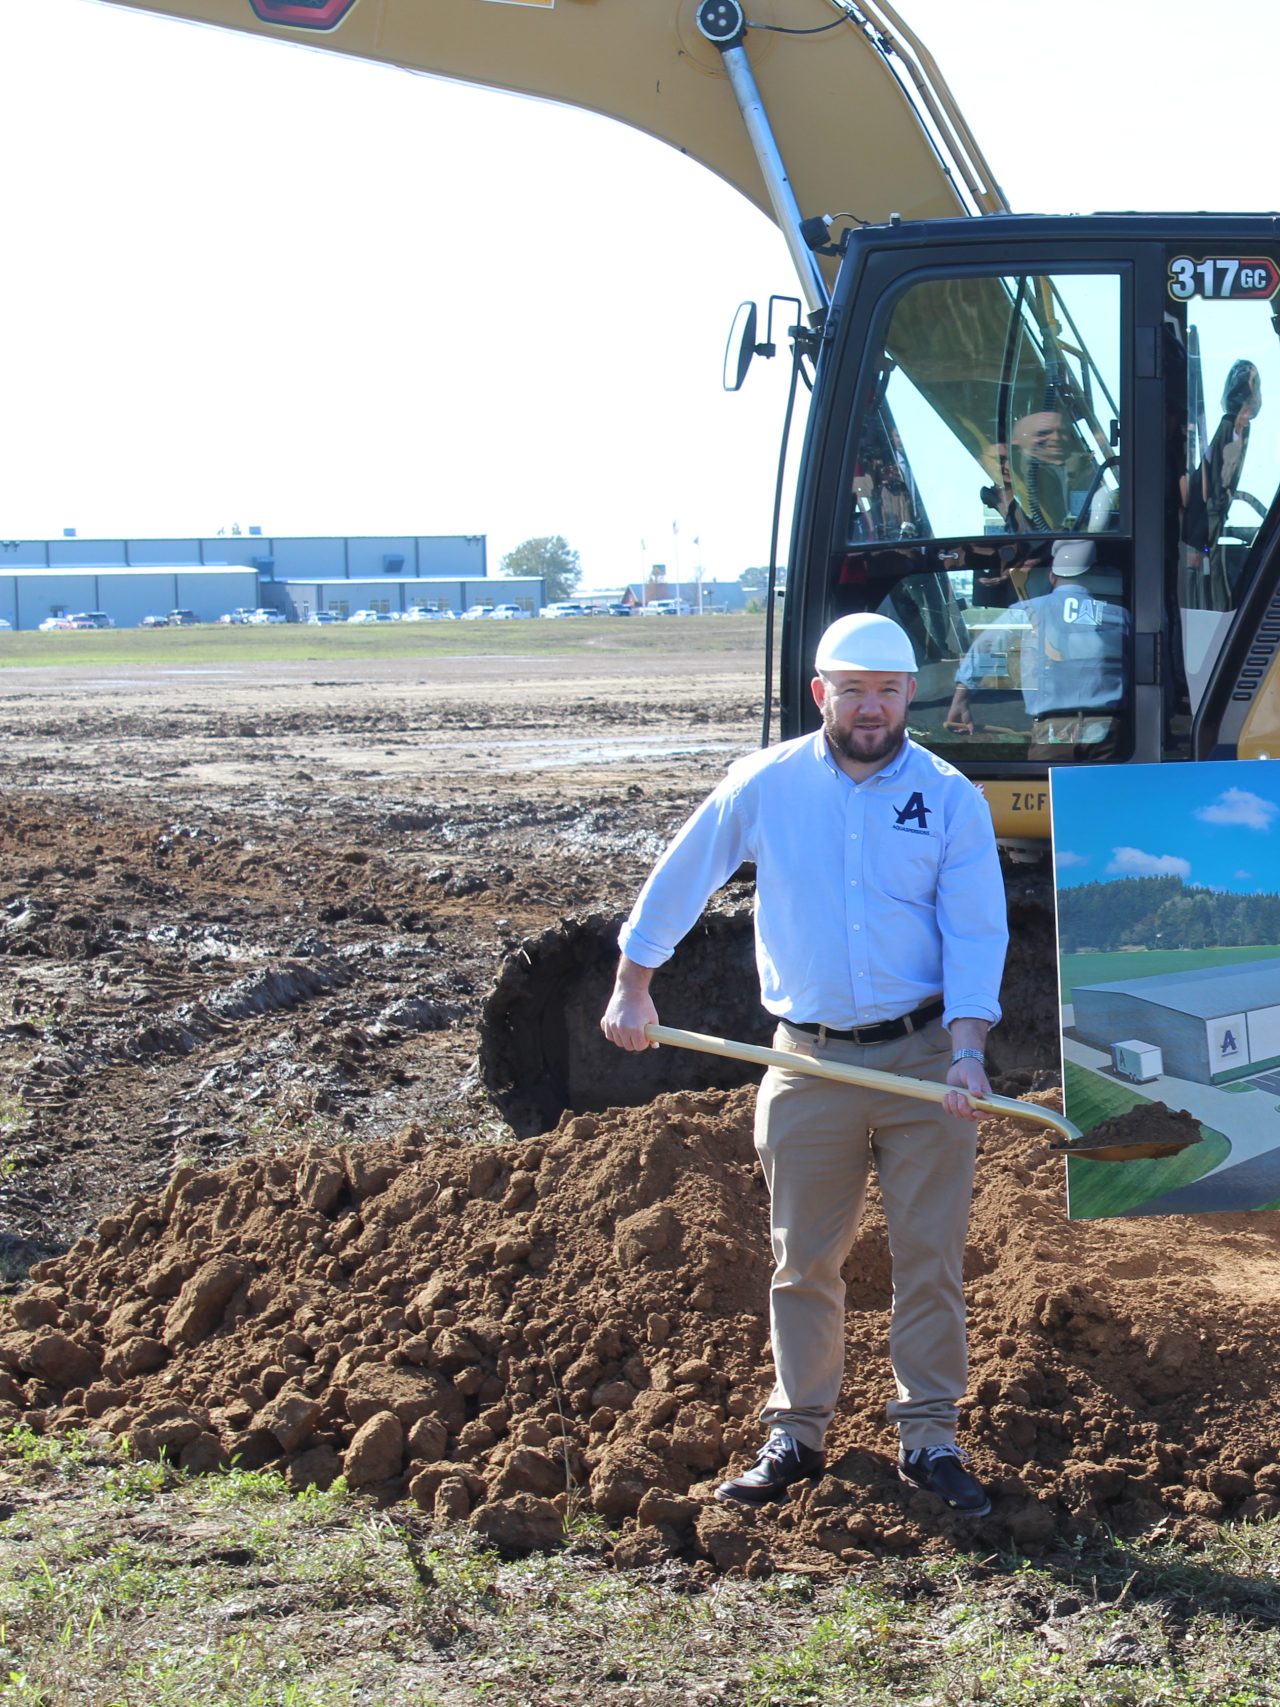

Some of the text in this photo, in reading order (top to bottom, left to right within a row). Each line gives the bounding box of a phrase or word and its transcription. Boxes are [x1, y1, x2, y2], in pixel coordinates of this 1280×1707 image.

[1171, 258, 1267, 298] 317 GC
[1063, 597, 1107, 626] CAT
[892, 791, 932, 829] A
[1011, 792, 1047, 811] ZCF
[1220, 1030, 1237, 1053] A
